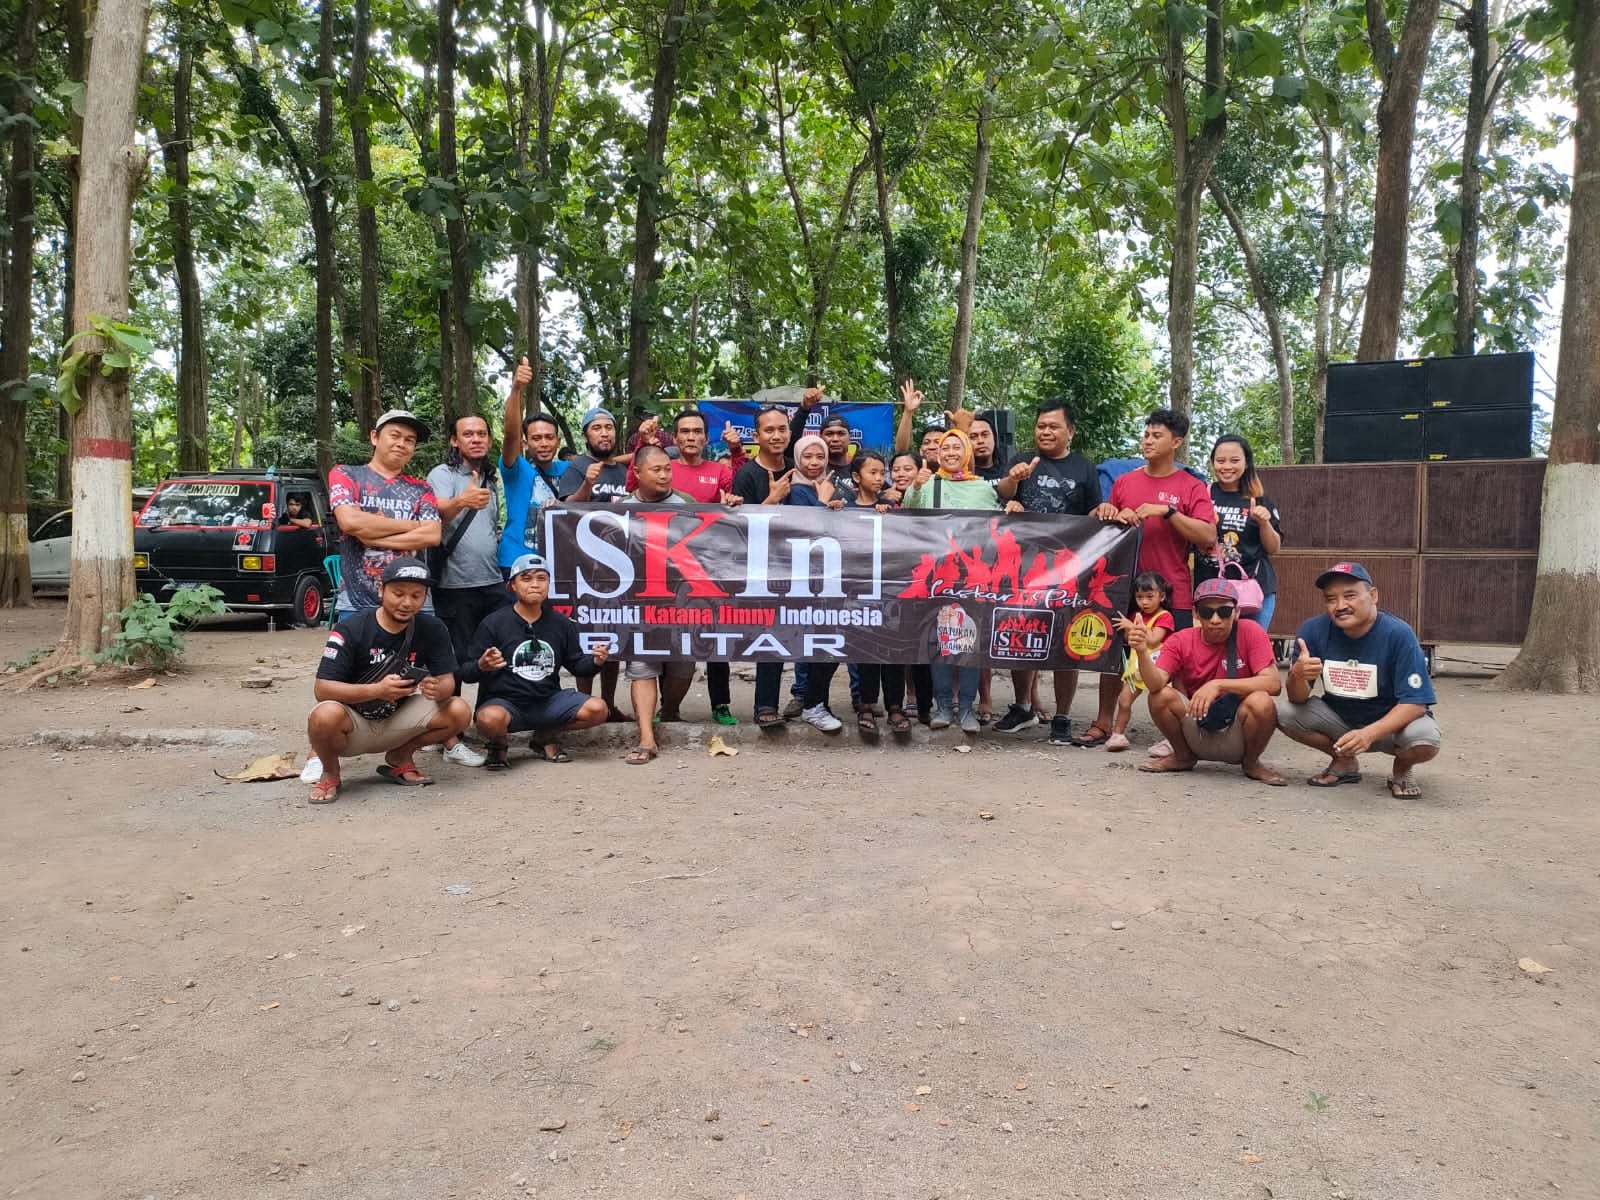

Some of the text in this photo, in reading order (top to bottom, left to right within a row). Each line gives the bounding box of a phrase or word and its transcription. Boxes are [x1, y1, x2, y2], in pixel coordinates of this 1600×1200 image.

[360, 495, 412, 510] JAMNAS
[928, 579, 1014, 601] Laskar
[577, 605, 883, 627] Suzuki Katana Jimny Indonesia
[578, 632, 849, 657] BLITAR
